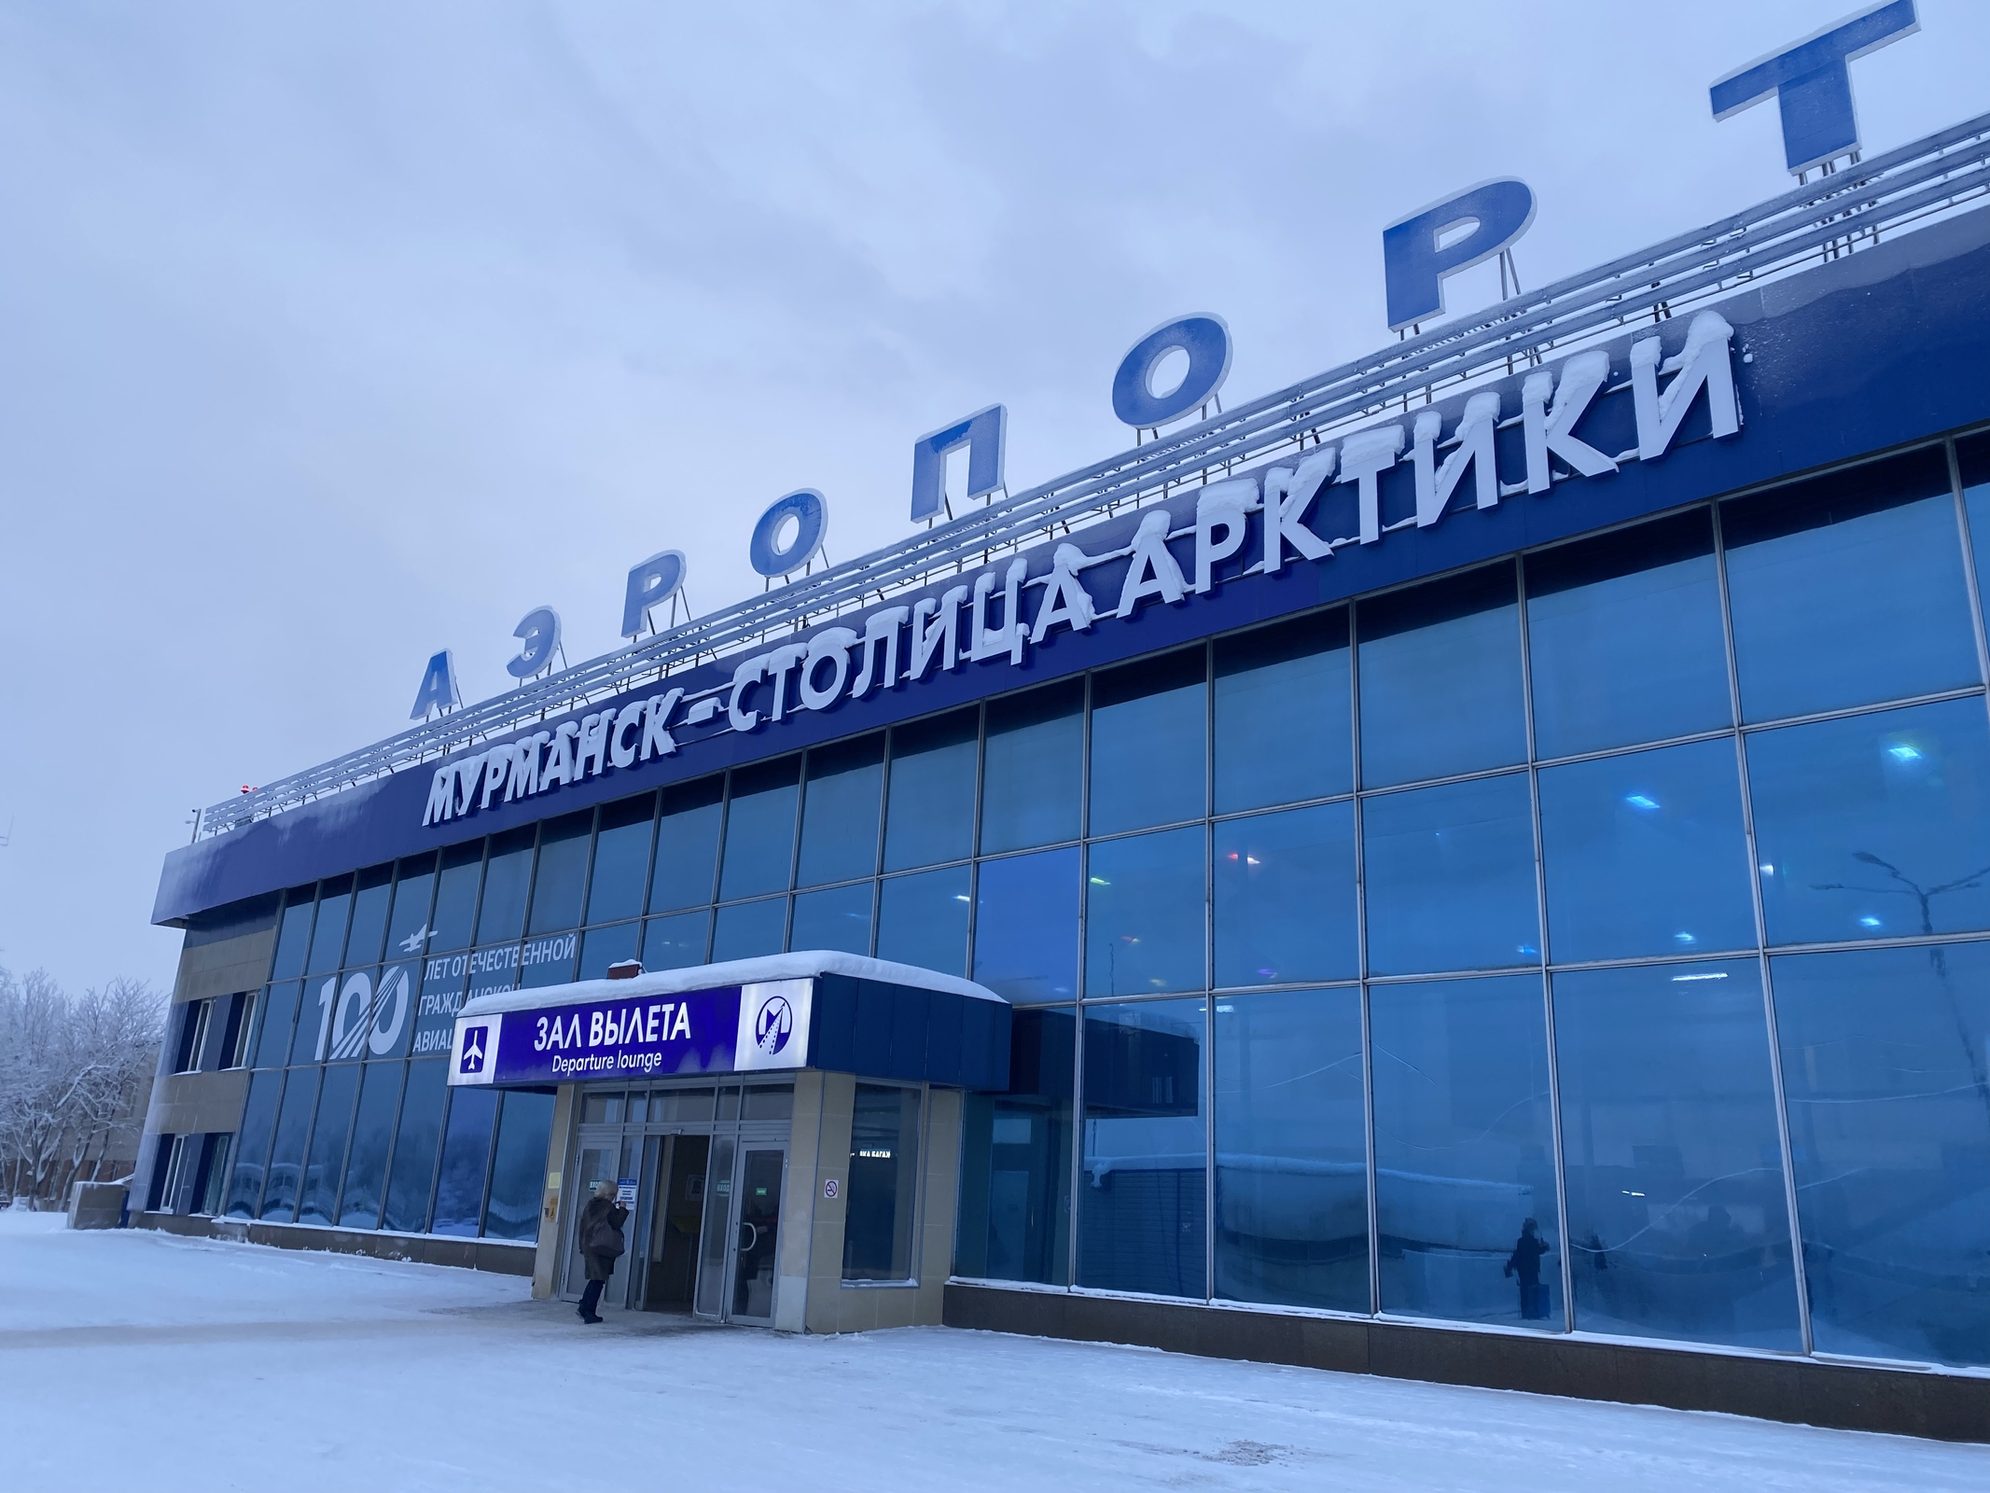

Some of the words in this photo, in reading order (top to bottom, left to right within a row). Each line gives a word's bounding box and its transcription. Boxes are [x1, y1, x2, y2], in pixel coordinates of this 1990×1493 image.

[410, 0, 1922, 720] АЭРОПОРТ
[1116, 311, 1742, 619] АРКТИКИ
[424, 957, 450, 981] ЛЕТ
[452, 934, 576, 977] ОТЕЧЕСТВЕННОЙ
[314, 966, 409, 1061] 100
[533, 1013, 582, 1051] ЗАЛ
[588, 1002, 691, 1047] ВЫЛЕТА
[552, 1053, 613, 1076] Departure
[617, 1050, 662, 1072] lounge
